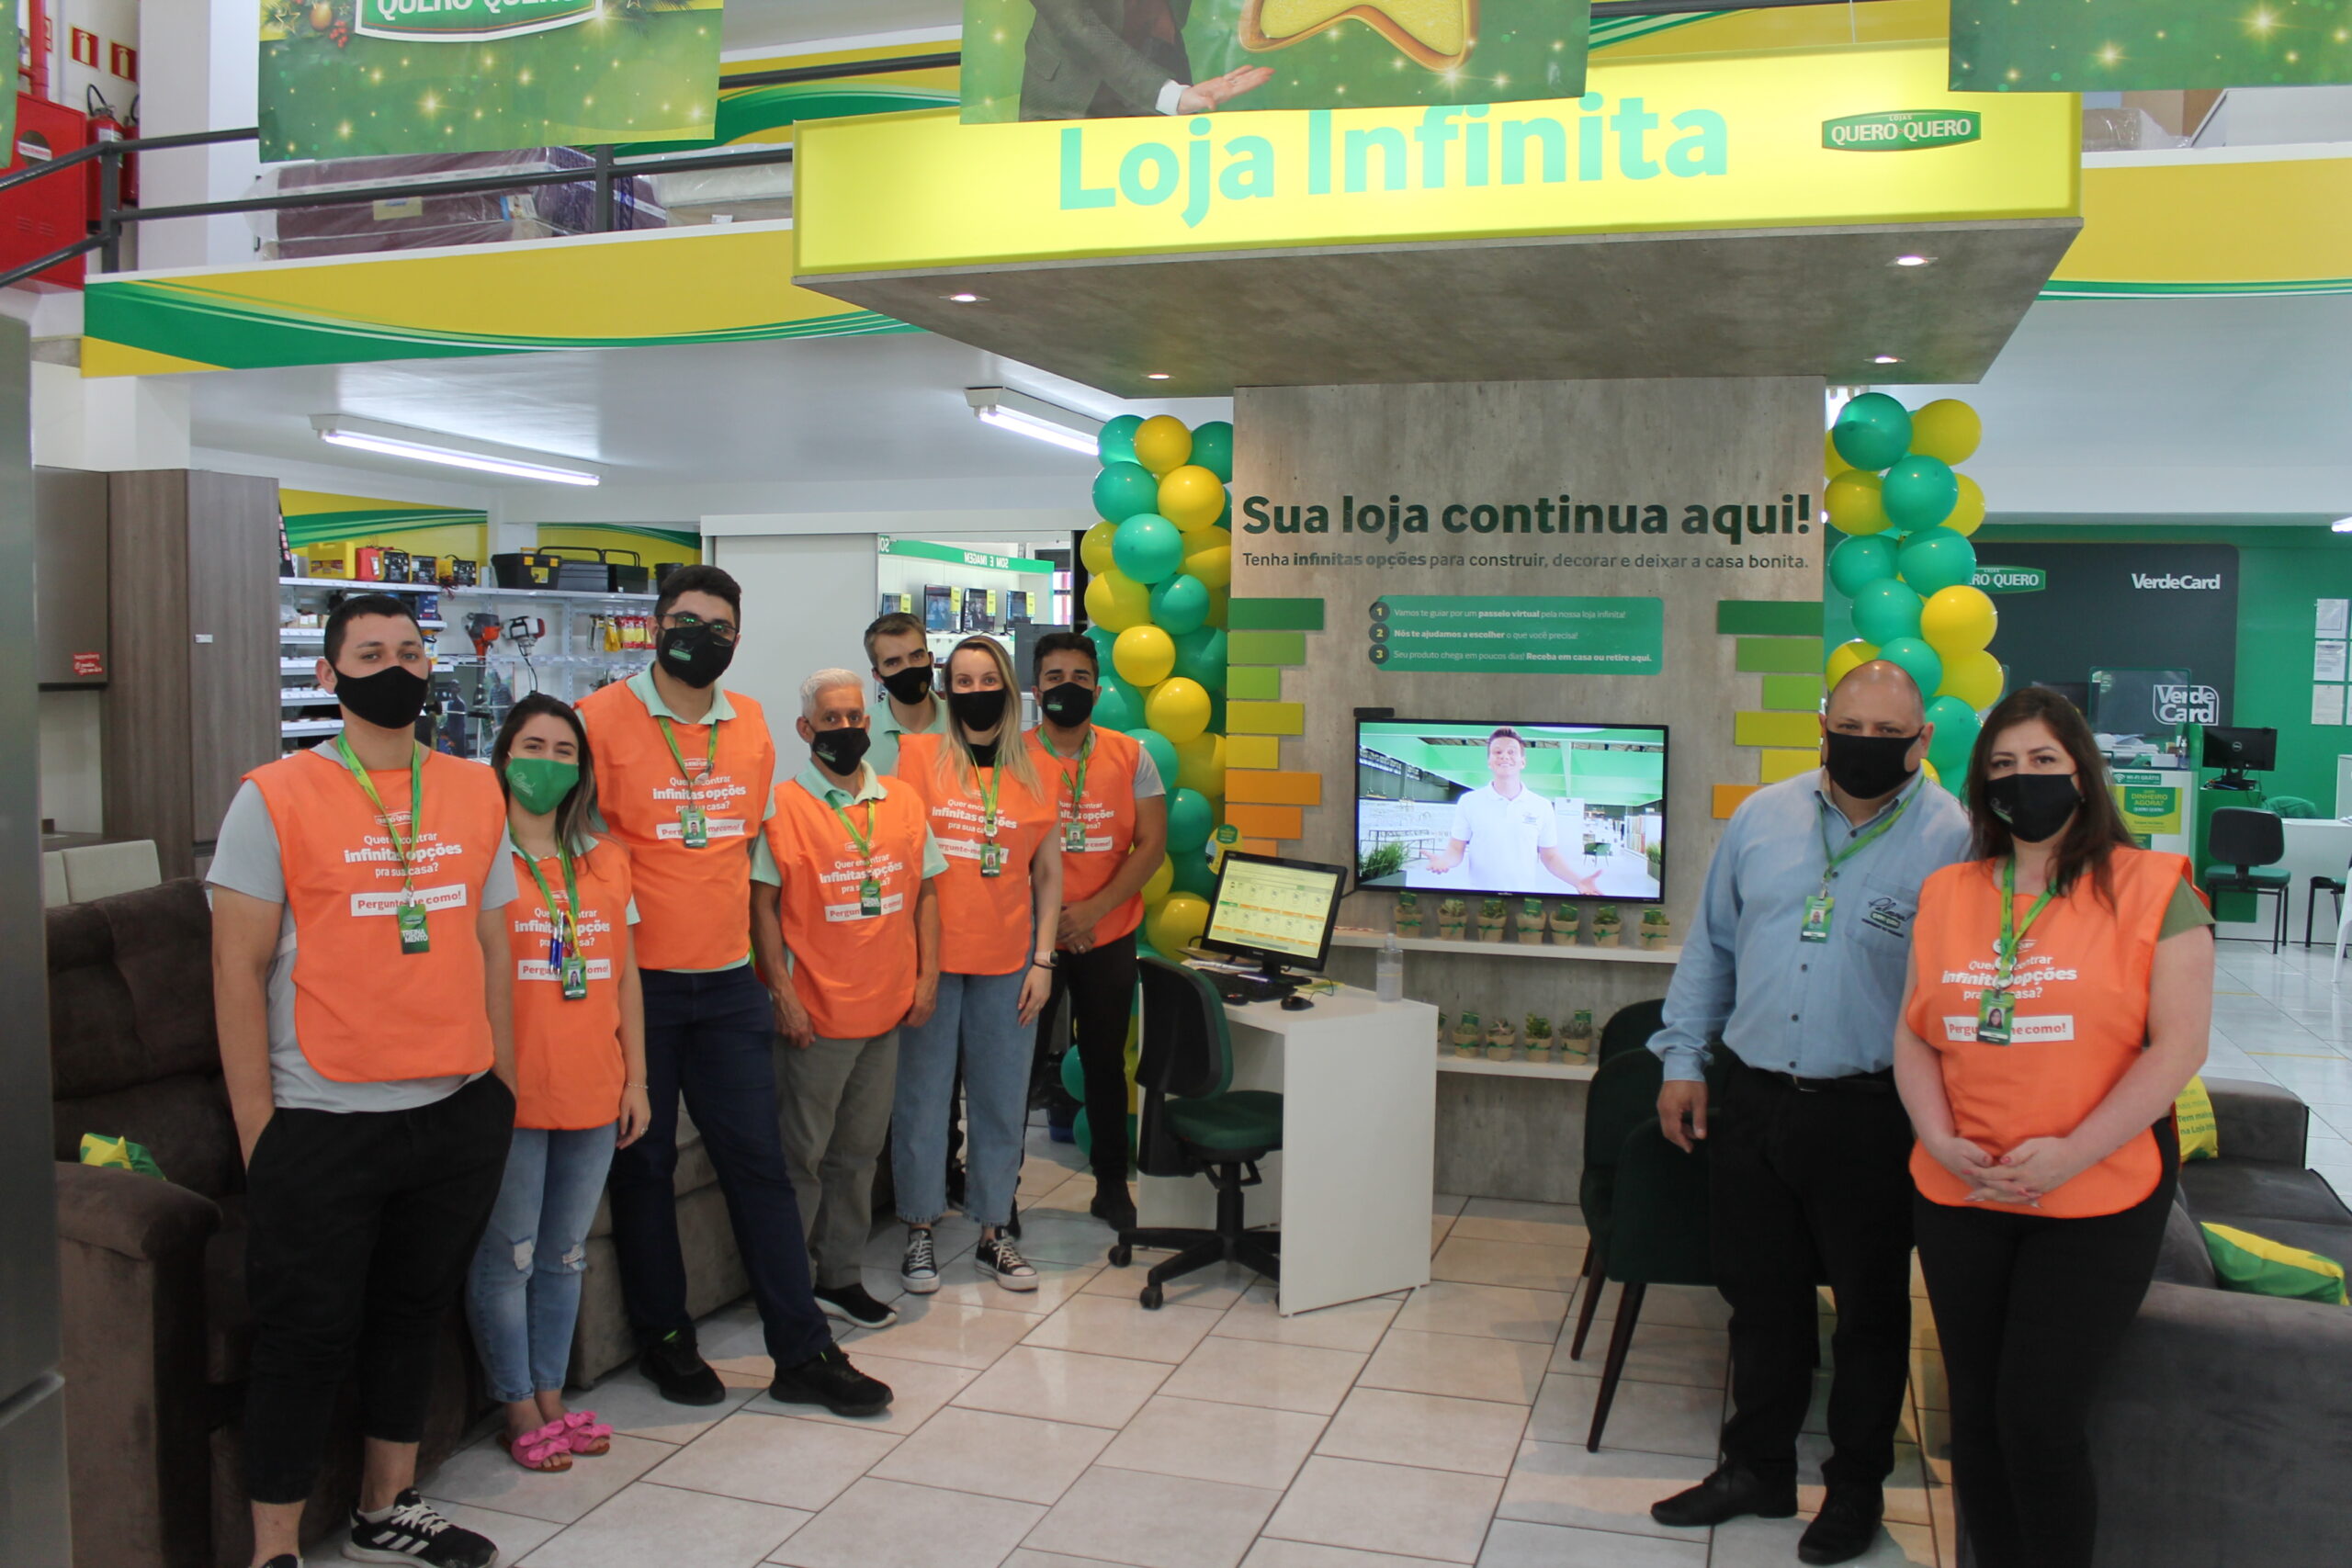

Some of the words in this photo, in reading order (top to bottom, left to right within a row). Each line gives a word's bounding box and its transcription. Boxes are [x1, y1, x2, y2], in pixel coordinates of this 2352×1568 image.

[1059, 116, 1275, 229] Loja
[1307, 91, 1729, 196] Infinita
[1242, 495, 1329, 535] Sua
[1342, 494, 1429, 545] loja
[1442, 494, 1668, 535] continua
[1681, 494, 1810, 545] aqui!
[1242, 553, 1290, 568] Tenha
[1293, 552, 1363, 567] infinitas
[1365, 551, 1427, 570] opções
[1430, 555, 1464, 570] para
[1469, 552, 1548, 568] construir,
[1553, 553, 1616, 568] decorar
[1621, 557, 1631, 567] e
[1634, 553, 1687, 568] deixar
[1690, 557, 1701, 568] a
[1705, 558, 1744, 569] casa
[1748, 553, 1808, 569] bonita.
[1994, 573, 2040, 588] QUERO
[2131, 573, 2221, 590] VerdeCard
[1376, 607, 1383, 616] 1
[1430, 609, 1449, 618] guiar
[1541, 610, 1557, 619] pela
[1582, 610, 1595, 619] loja
[1376, 628, 1384, 637] 2
[1394, 629, 1410, 637] Nós
[1421, 630, 1462, 639] ajudamos
[1513, 632, 1528, 640] que
[1529, 631, 1548, 639] você
[1375, 649, 1384, 659] 3
[1394, 650, 1409, 659] Seu
[1409, 651, 1439, 660] produto
[1441, 651, 1464, 660] chega
[1526, 652, 1556, 660] Receba
[1606, 653, 1629, 661] retire
[2157, 687, 2216, 705] Verde
[2158, 704, 2215, 724] Card
[406, 842, 462, 863] opções
[375, 867, 390, 878] pra
[408, 863, 439, 876] casa?
[425, 890, 461, 905] como!
[577, 919, 611, 937] pções
[2013, 966, 2078, 987] opções
[2014, 987, 2042, 999] asa?
[2024, 1022, 2066, 1034] como!
